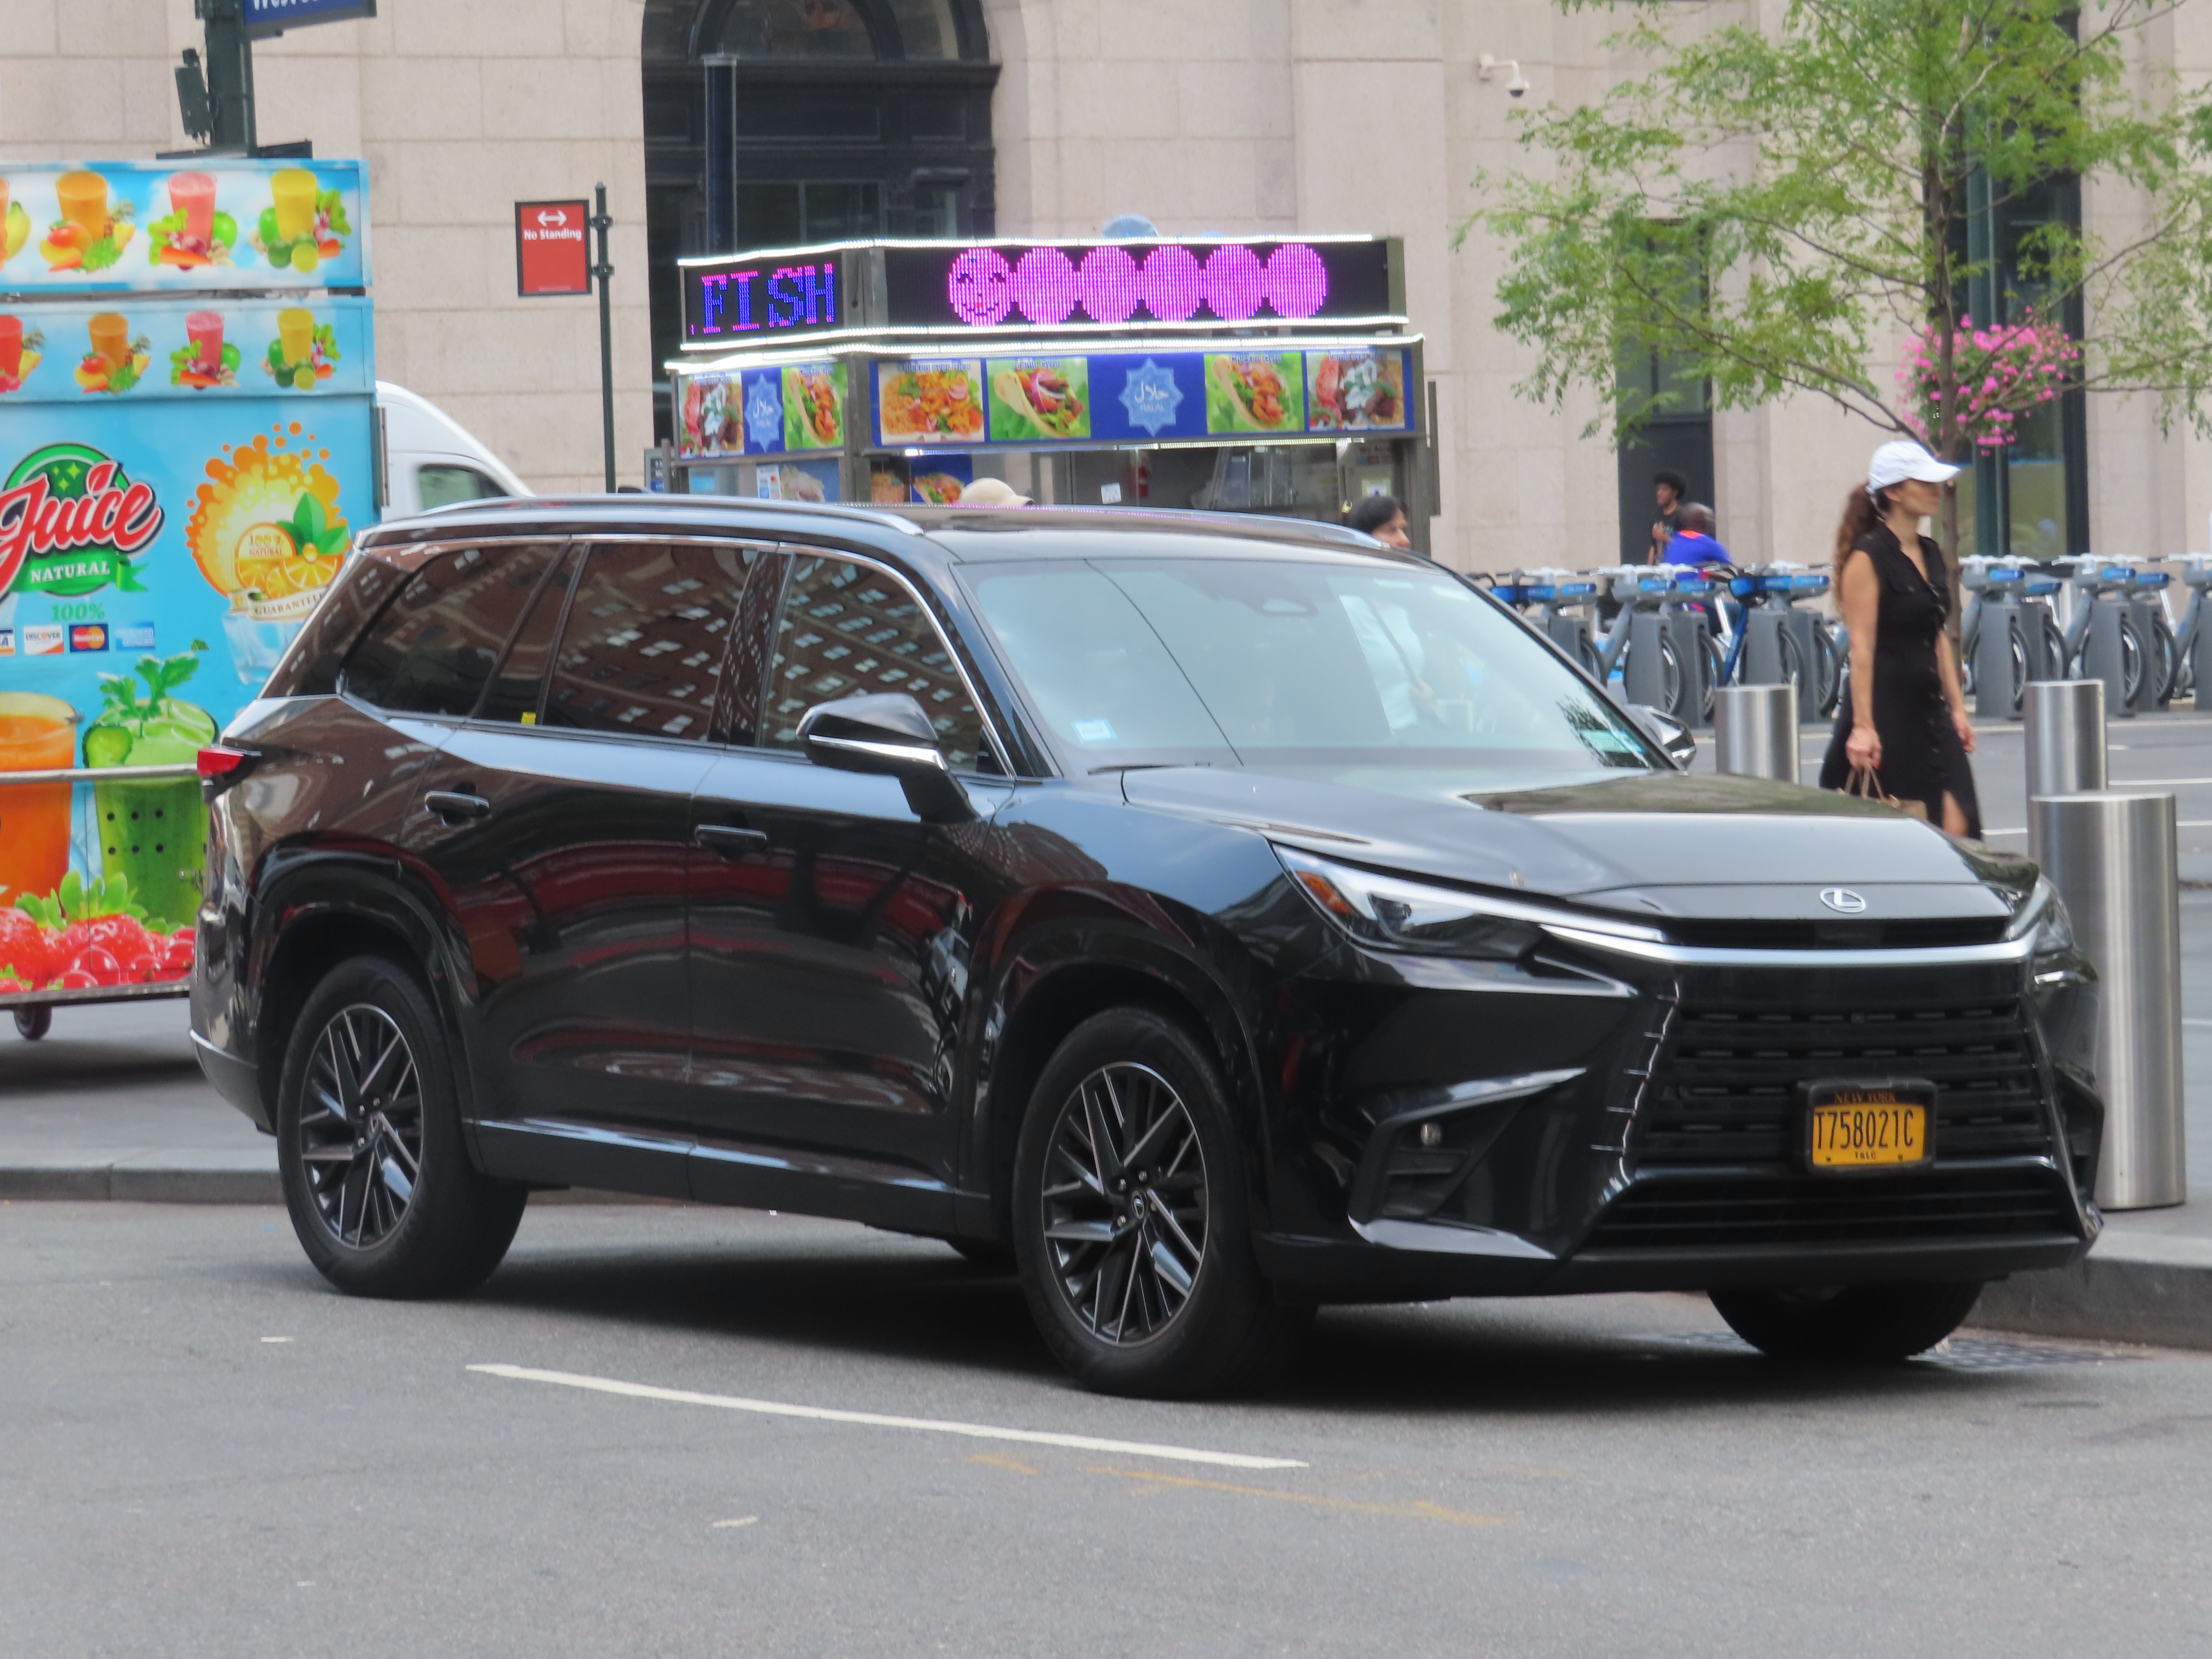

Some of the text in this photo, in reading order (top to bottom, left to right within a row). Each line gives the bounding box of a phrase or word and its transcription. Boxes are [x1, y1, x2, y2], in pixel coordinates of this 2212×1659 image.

[524, 227, 582, 241] No Standing
[701, 262, 835, 334] FISH
[0, 460, 161, 595] Juice
[30, 561, 111, 584] NATURAL
[52, 603, 105, 621] 100%
[1814, 1109, 1913, 1149] T758021C
